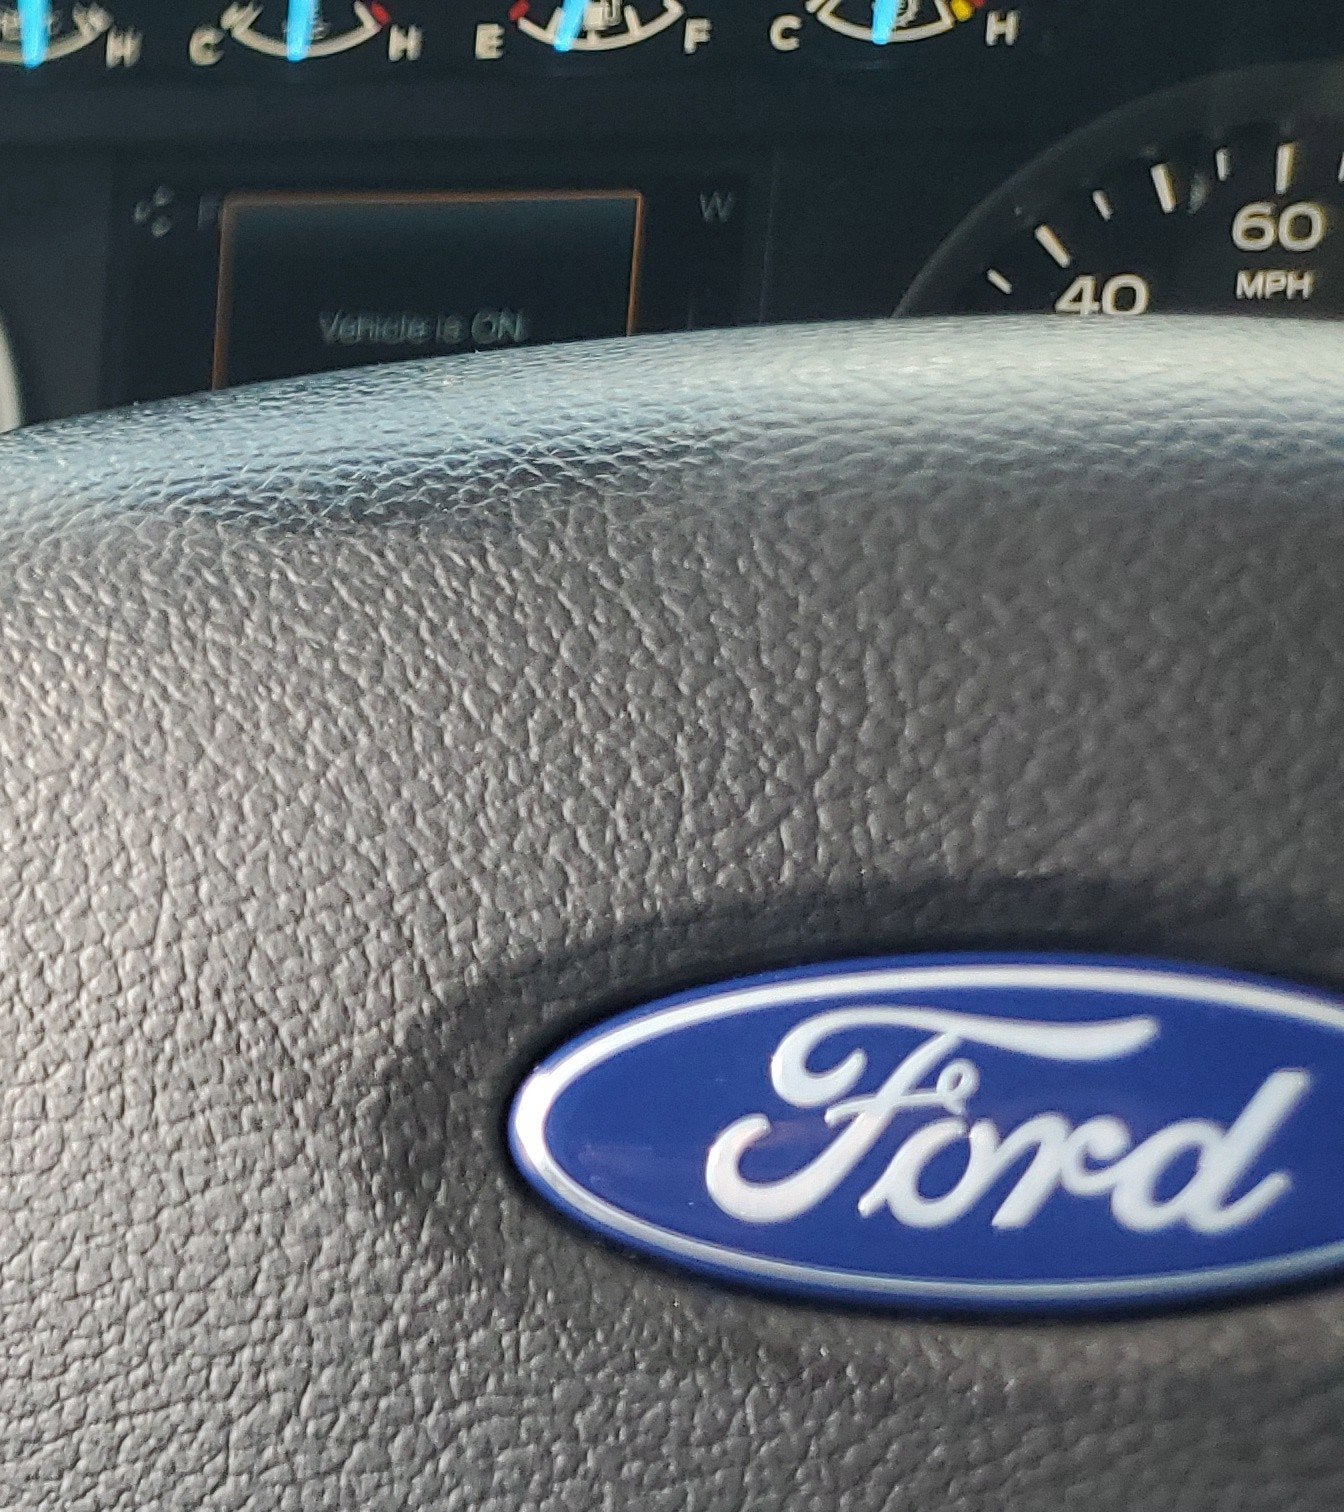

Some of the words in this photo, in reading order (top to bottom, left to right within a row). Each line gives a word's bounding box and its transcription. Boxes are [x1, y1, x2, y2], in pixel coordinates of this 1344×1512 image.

[188, 24, 225, 66] C
[388, 26, 422, 62] H
[475, 23, 505, 60] E
[683, 18, 711, 53] F
[769, 15, 800, 51] C
[986, 12, 1020, 46] H
[1232, 201, 1325, 251] 60
[1054, 273, 1150, 315] 40
[1235, 268, 1313, 300] MPH
[319, 308, 430, 346] Vehicle
[470, 307, 527, 345] ON
[705, 1005, 1311, 1235] Ford
